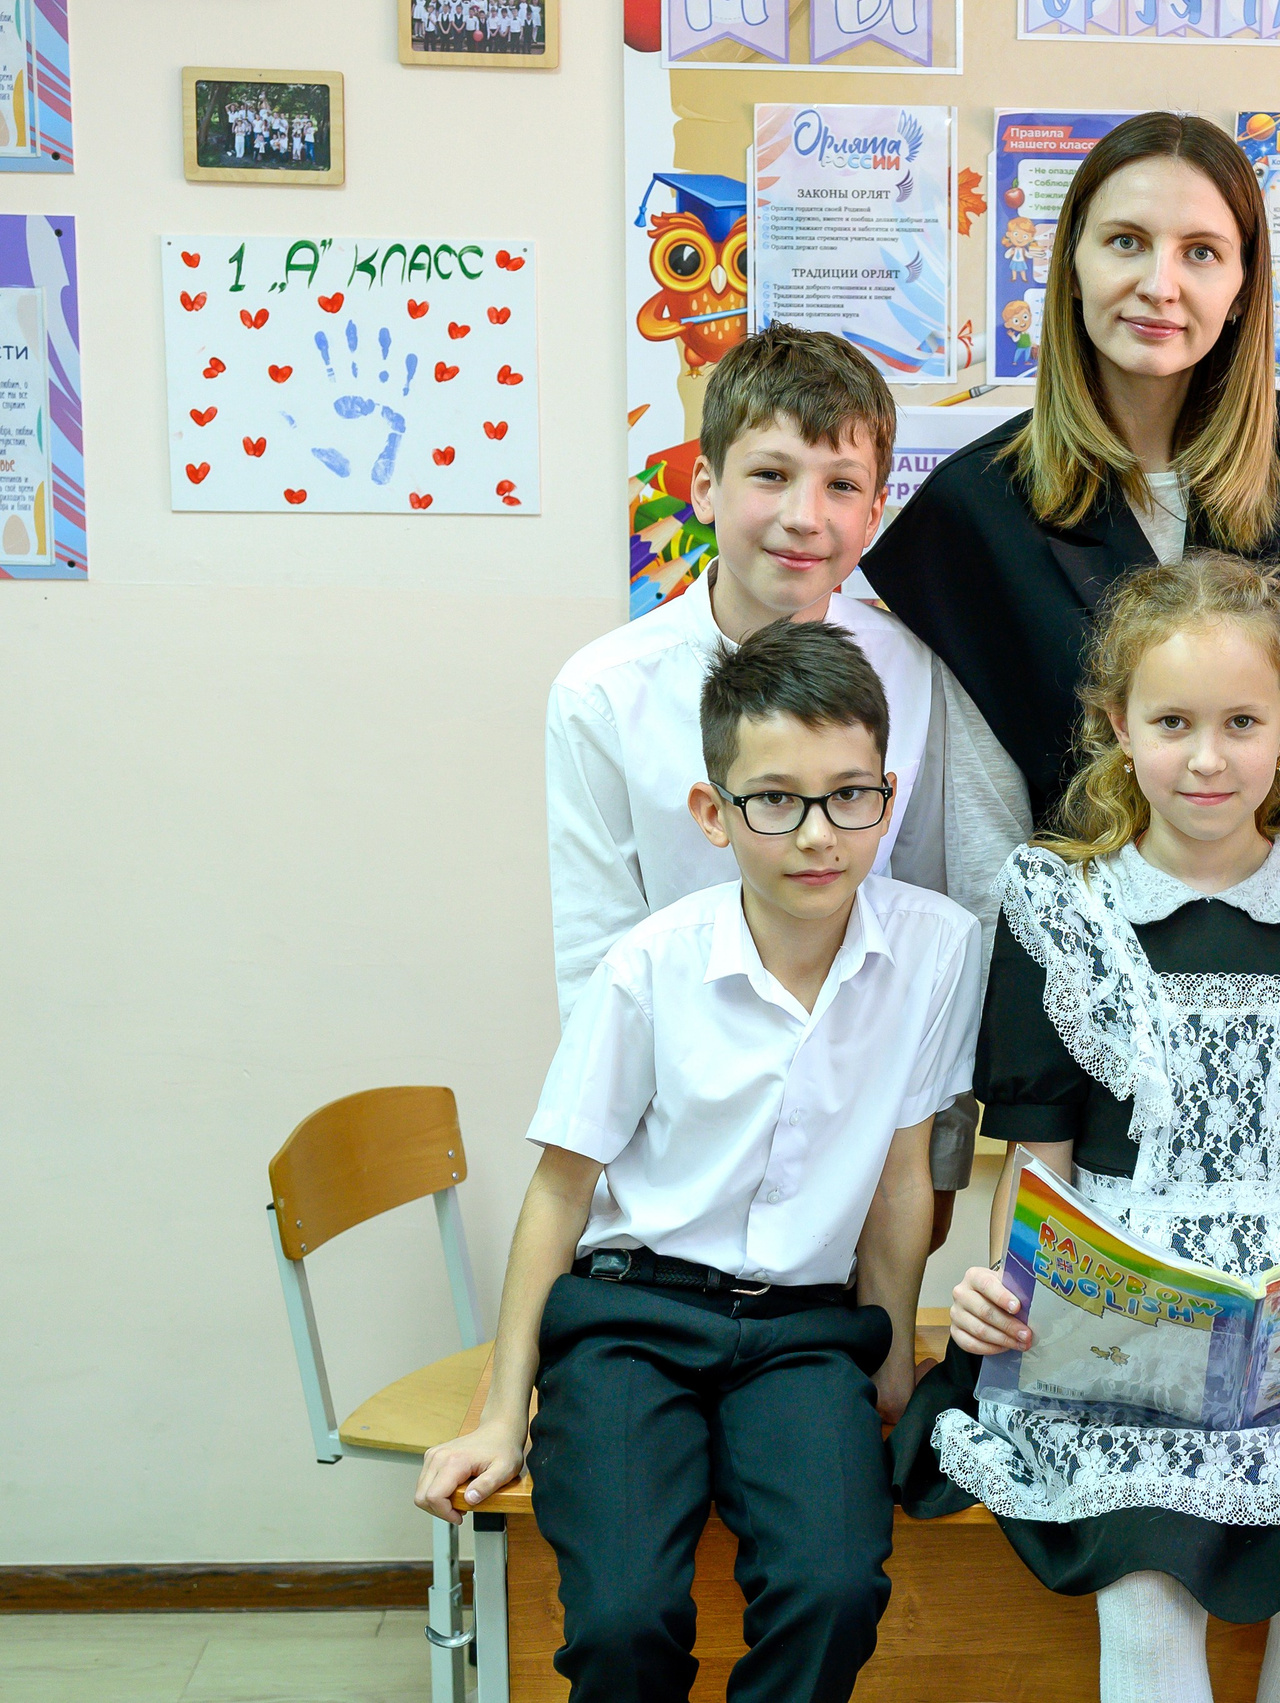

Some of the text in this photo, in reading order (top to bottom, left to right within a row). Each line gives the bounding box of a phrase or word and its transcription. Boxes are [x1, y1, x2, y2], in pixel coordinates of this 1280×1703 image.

[794, 109, 902, 162] Орлята
[1010, 128, 1064, 138] Правила
[1010, 141, 1096, 150] нашего класс
[820, 155, 900, 170] РОССИИ
[1034, 180, 1072, 188] Соблюд
[797, 189, 891, 199] ЗАКОНЫ ОРЛЯТ
[228, 242, 246, 292] 1
[347, 243, 484, 291] КЛАСС
[792, 268, 900, 279] ТРАДИЦИИ ОРЛЯТ
[1039, 1221, 1224, 1318] RAINBOW
[1032, 1250, 1193, 1323] ENGLISH
